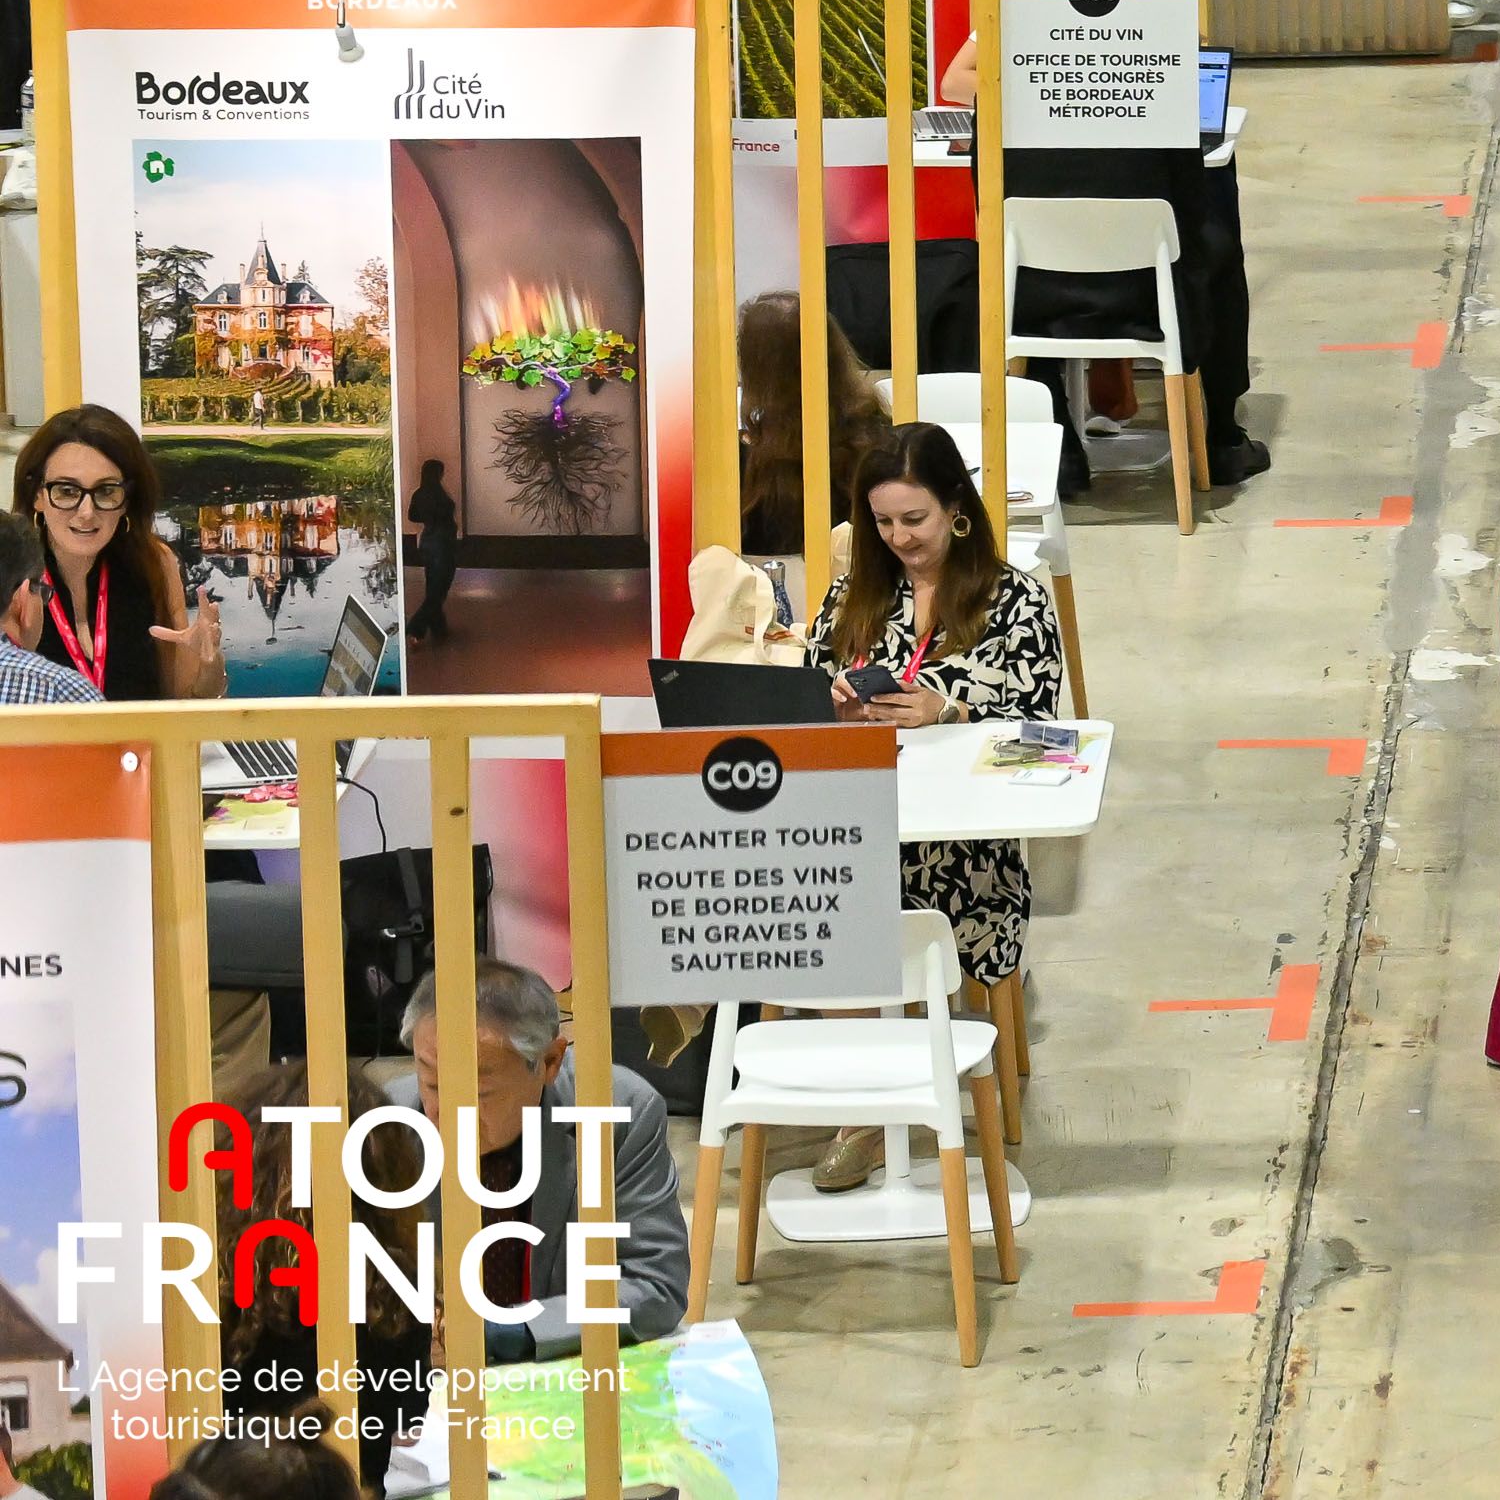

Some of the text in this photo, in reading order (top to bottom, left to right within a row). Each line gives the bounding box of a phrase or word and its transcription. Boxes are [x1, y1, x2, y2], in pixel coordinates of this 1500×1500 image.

[1050, 26, 1143, 41] CITÉ DU VIN
[1013, 54, 1181, 66] OFFICE DE TOURISME
[433, 73, 482, 95] Cité
[1029, 69, 1165, 83] ET DES CONGRÈS
[135, 72, 310, 105] Bordeaux
[1040, 88, 1154, 100] DE BORDEAUX
[137, 108, 310, 120] Tourism & Conventions
[429, 99, 505, 119] du Vin
[1049, 103, 1146, 118] MÉTROPOLE
[732, 139, 780, 152] France
[707, 760, 777, 791] C09
[626, 826, 863, 852] DECANTER TOURS
[637, 866, 853, 892] ROUTE DES VINS
[651, 894, 841, 918] DE BORDEAUX
[661, 921, 832, 945] EN GRAVES &
[0, 955, 63, 977] NES
[671, 949, 824, 972] SAUTERNES
